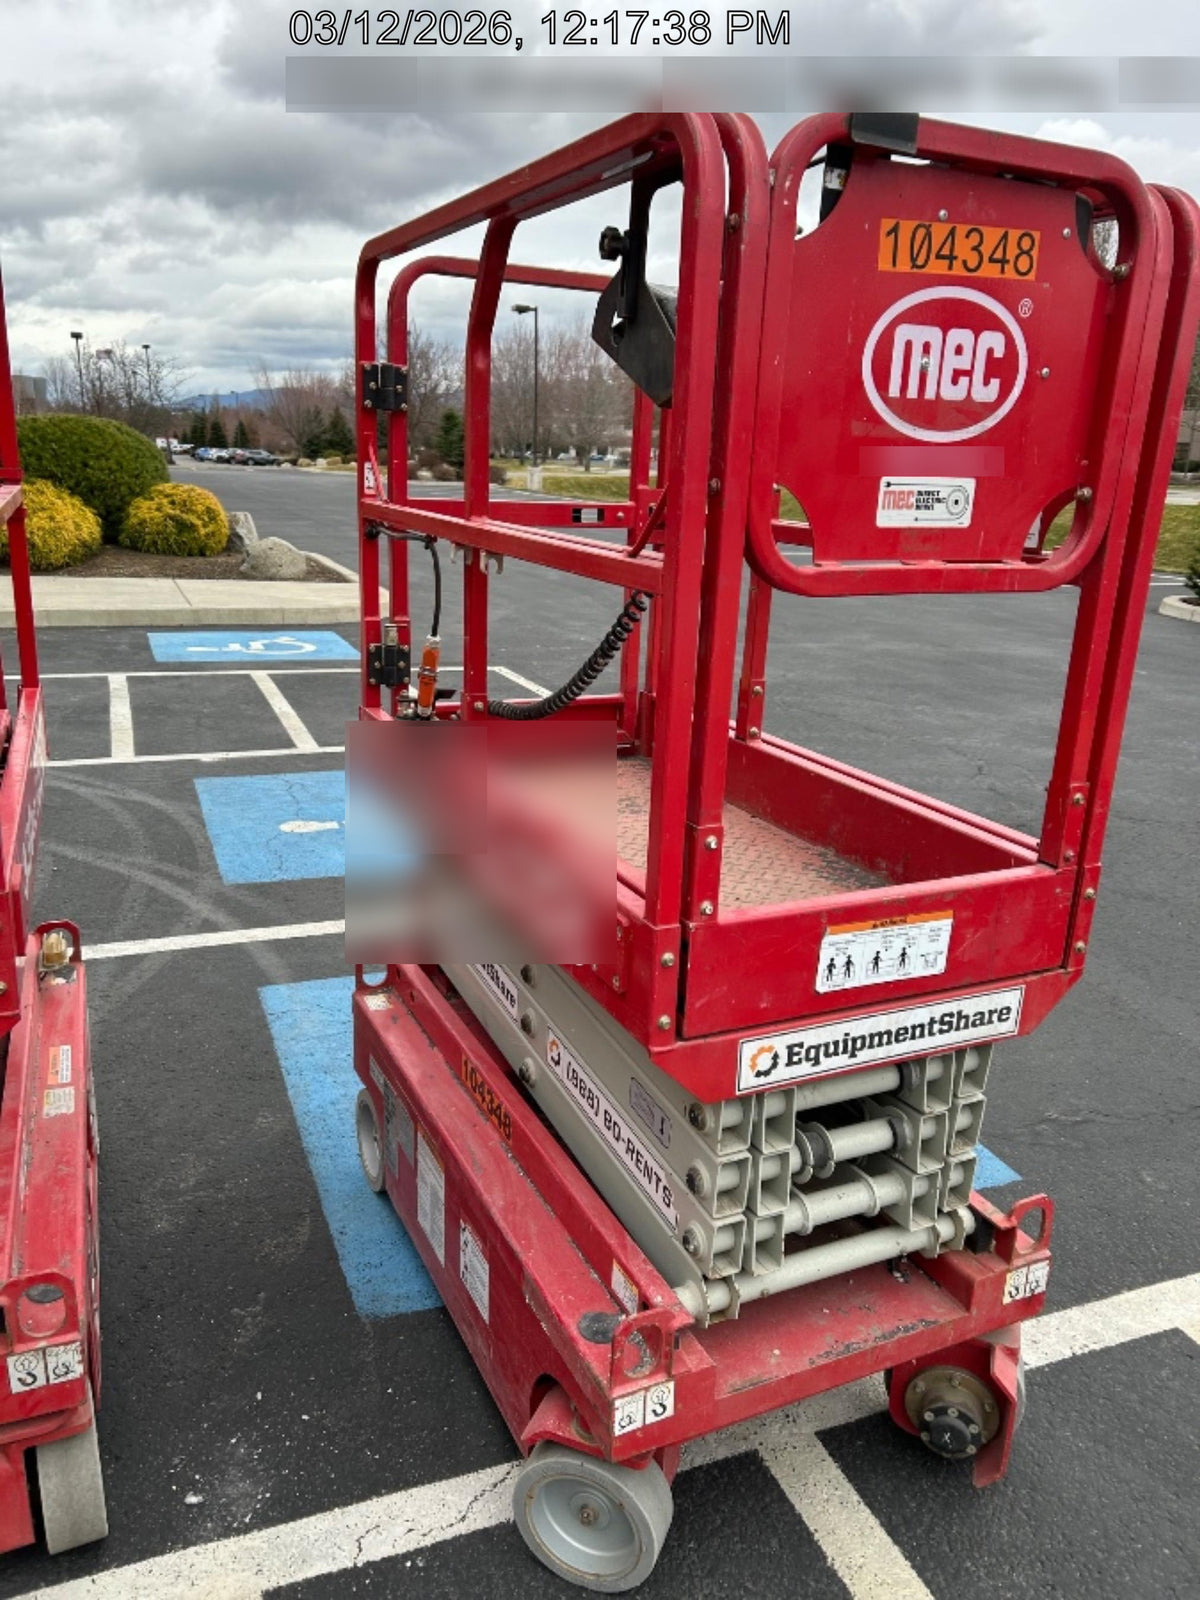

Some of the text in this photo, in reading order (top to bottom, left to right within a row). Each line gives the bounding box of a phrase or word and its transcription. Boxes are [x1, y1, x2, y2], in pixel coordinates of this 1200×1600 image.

[885, 221, 1036, 276] 104348
[785, 1005, 1012, 1068] EquipmentShare
[464, 1060, 511, 1141] 104348
